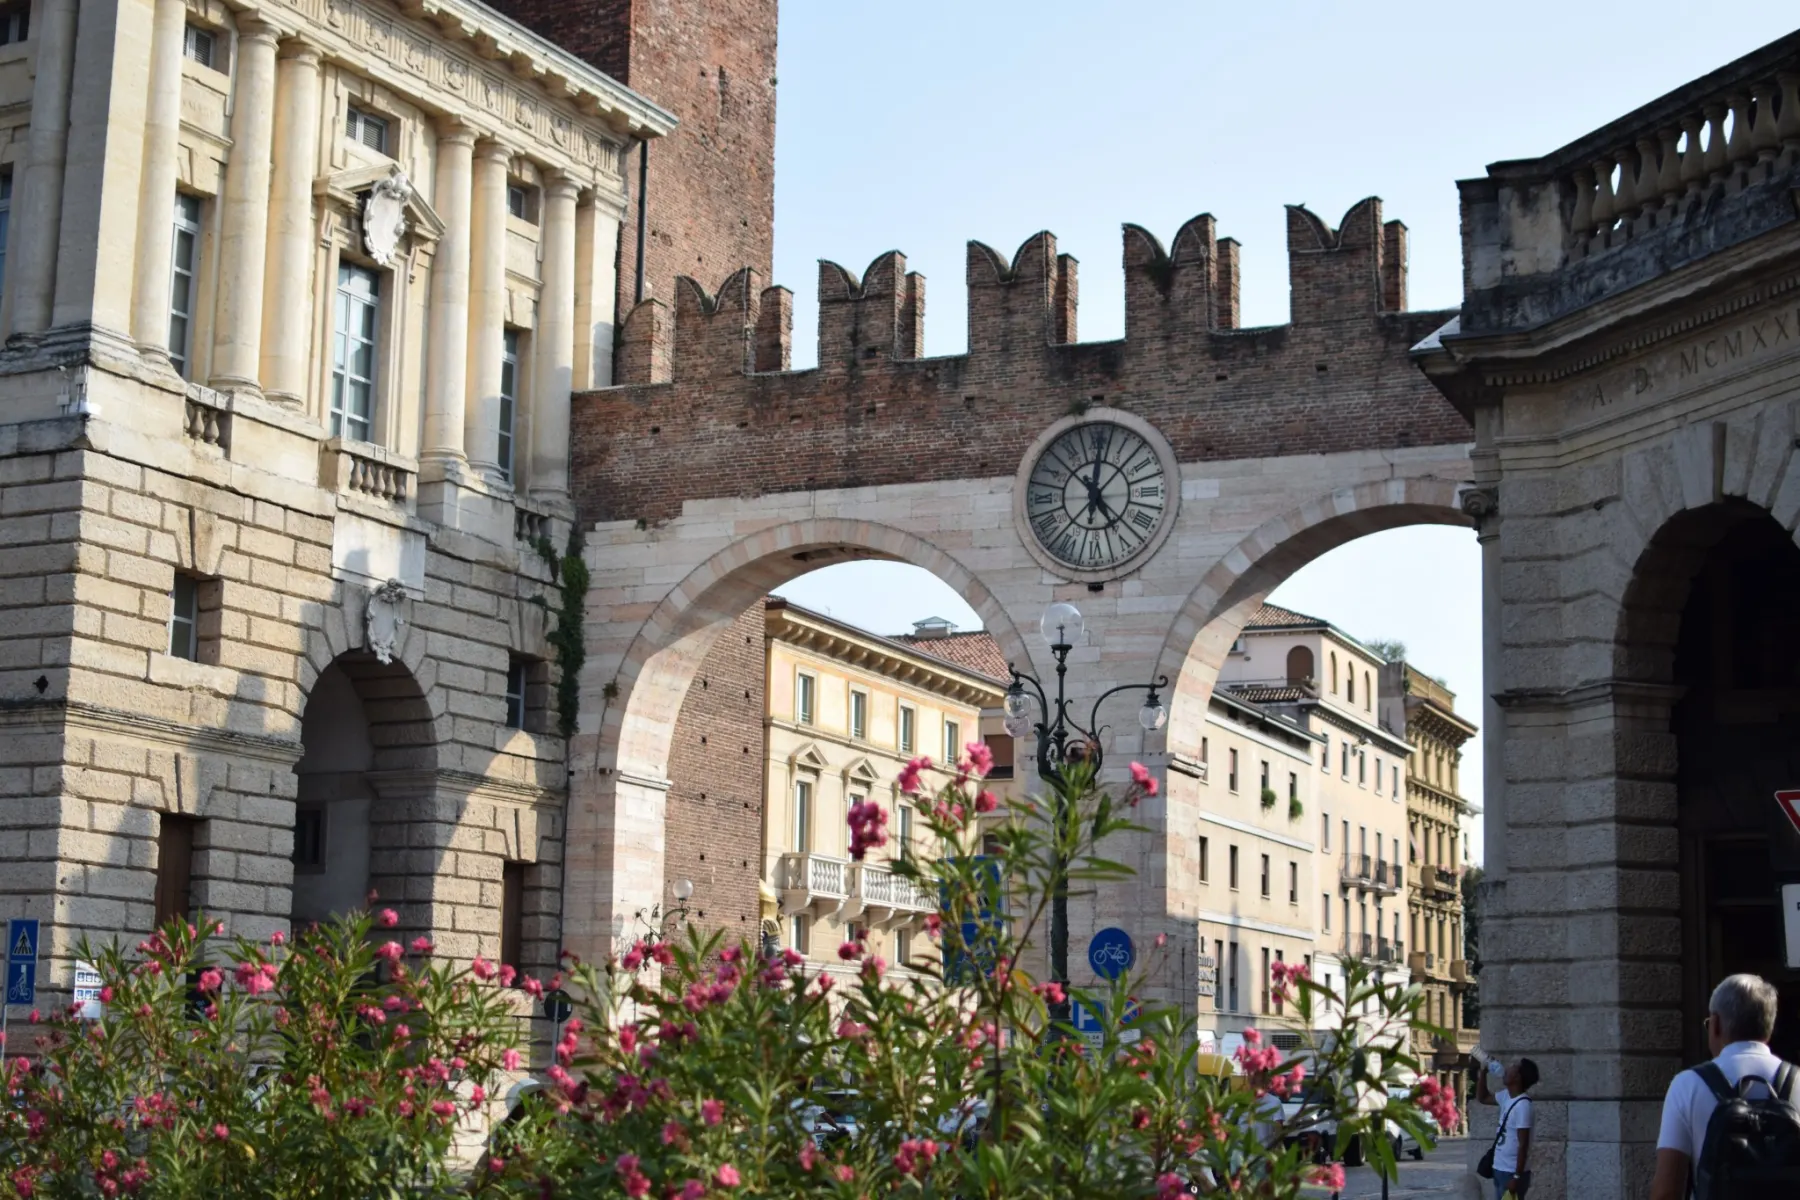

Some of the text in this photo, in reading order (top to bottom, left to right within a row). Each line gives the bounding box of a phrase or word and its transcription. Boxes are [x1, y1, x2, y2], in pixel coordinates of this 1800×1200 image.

[1591, 383, 1612, 410] A.
[1635, 367, 1654, 395] D.
[1134, 457, 1151, 473] II
[1035, 491, 1053, 504] IX
[1132, 487, 1141, 498] 15
[1141, 486, 1159, 498] III
[1056, 514, 1067, 524] 20
[1132, 509, 1153, 531] IIII
[1072, 527, 1081, 537] 19
[1091, 530, 1100, 541] 18
[1118, 534, 1131, 552] V
[1089, 541, 1103, 560] VI
[1078, 1003, 1095, 1029] P
